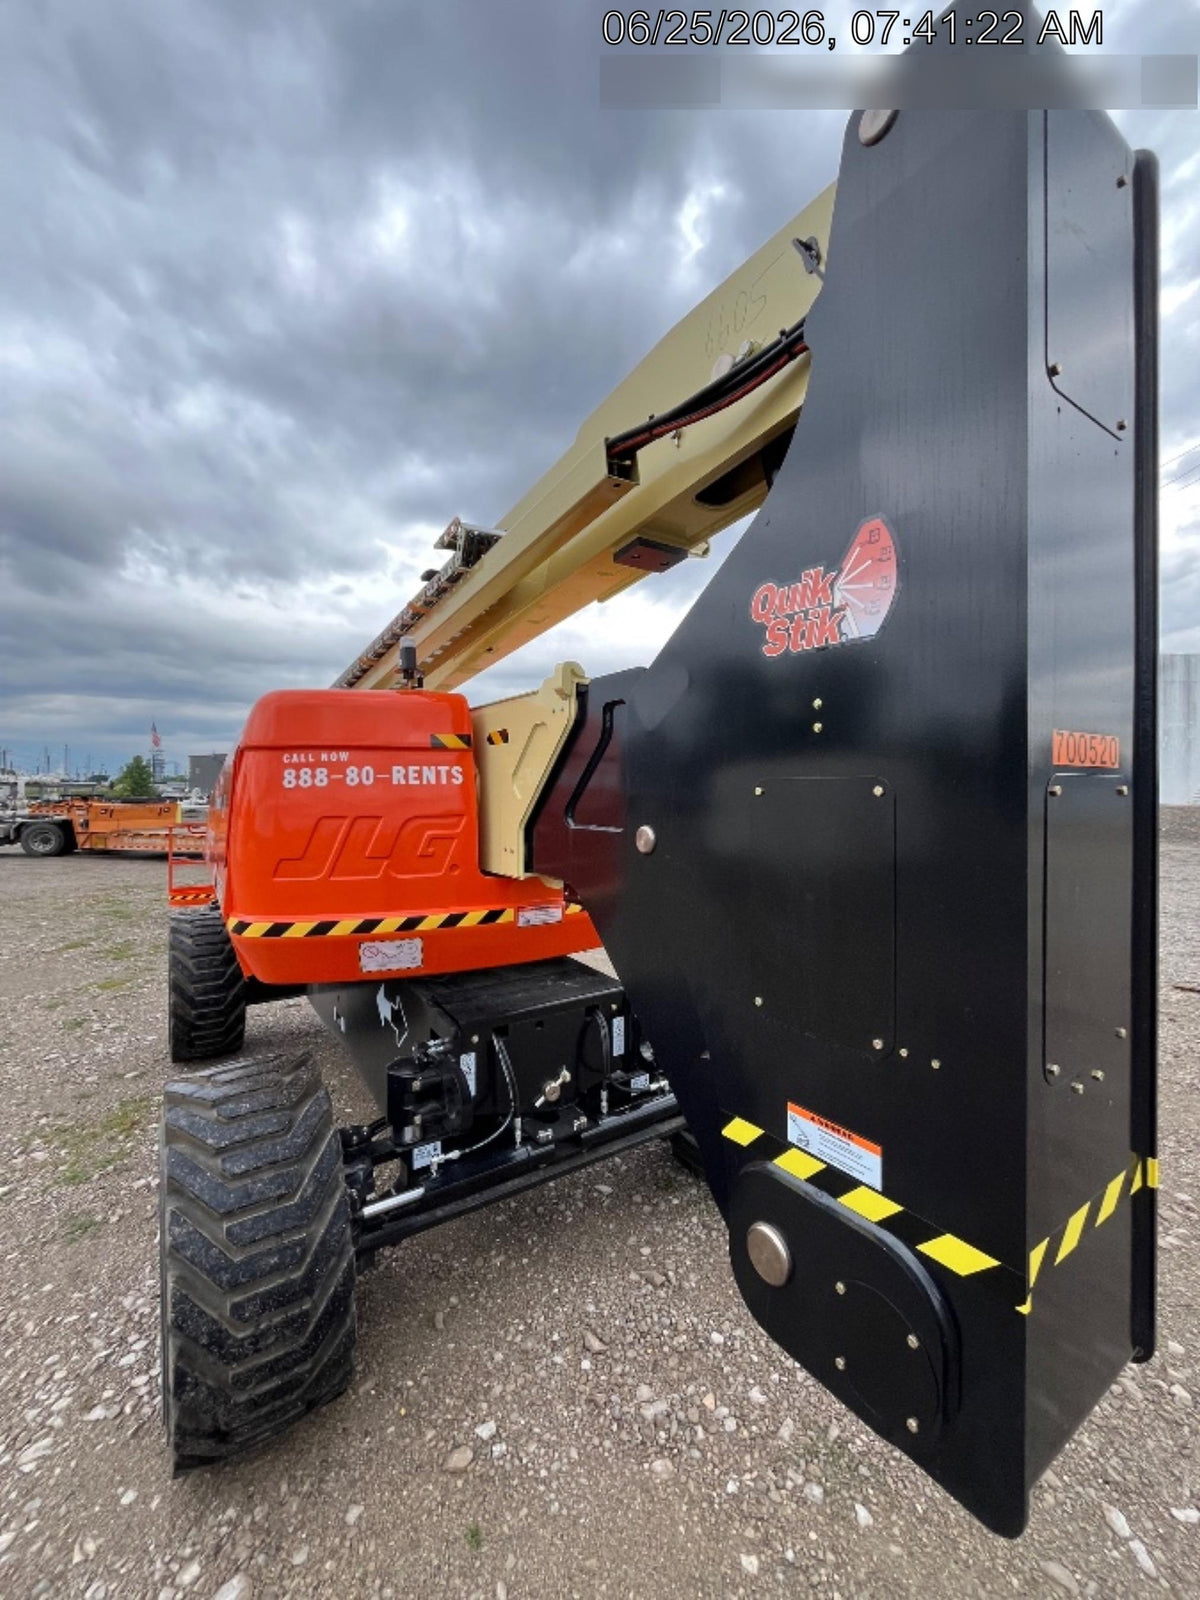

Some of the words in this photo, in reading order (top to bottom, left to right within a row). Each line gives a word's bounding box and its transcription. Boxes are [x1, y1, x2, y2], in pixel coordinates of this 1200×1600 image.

[751, 566, 837, 624] Quik
[762, 603, 847, 657] Stik
[282, 752, 315, 764] CALL
[321, 751, 350, 762] NOW
[1055, 731, 1118, 766] 700520
[282, 765, 464, 789] 888-80-RENTS
[272, 814, 466, 881] JLG
